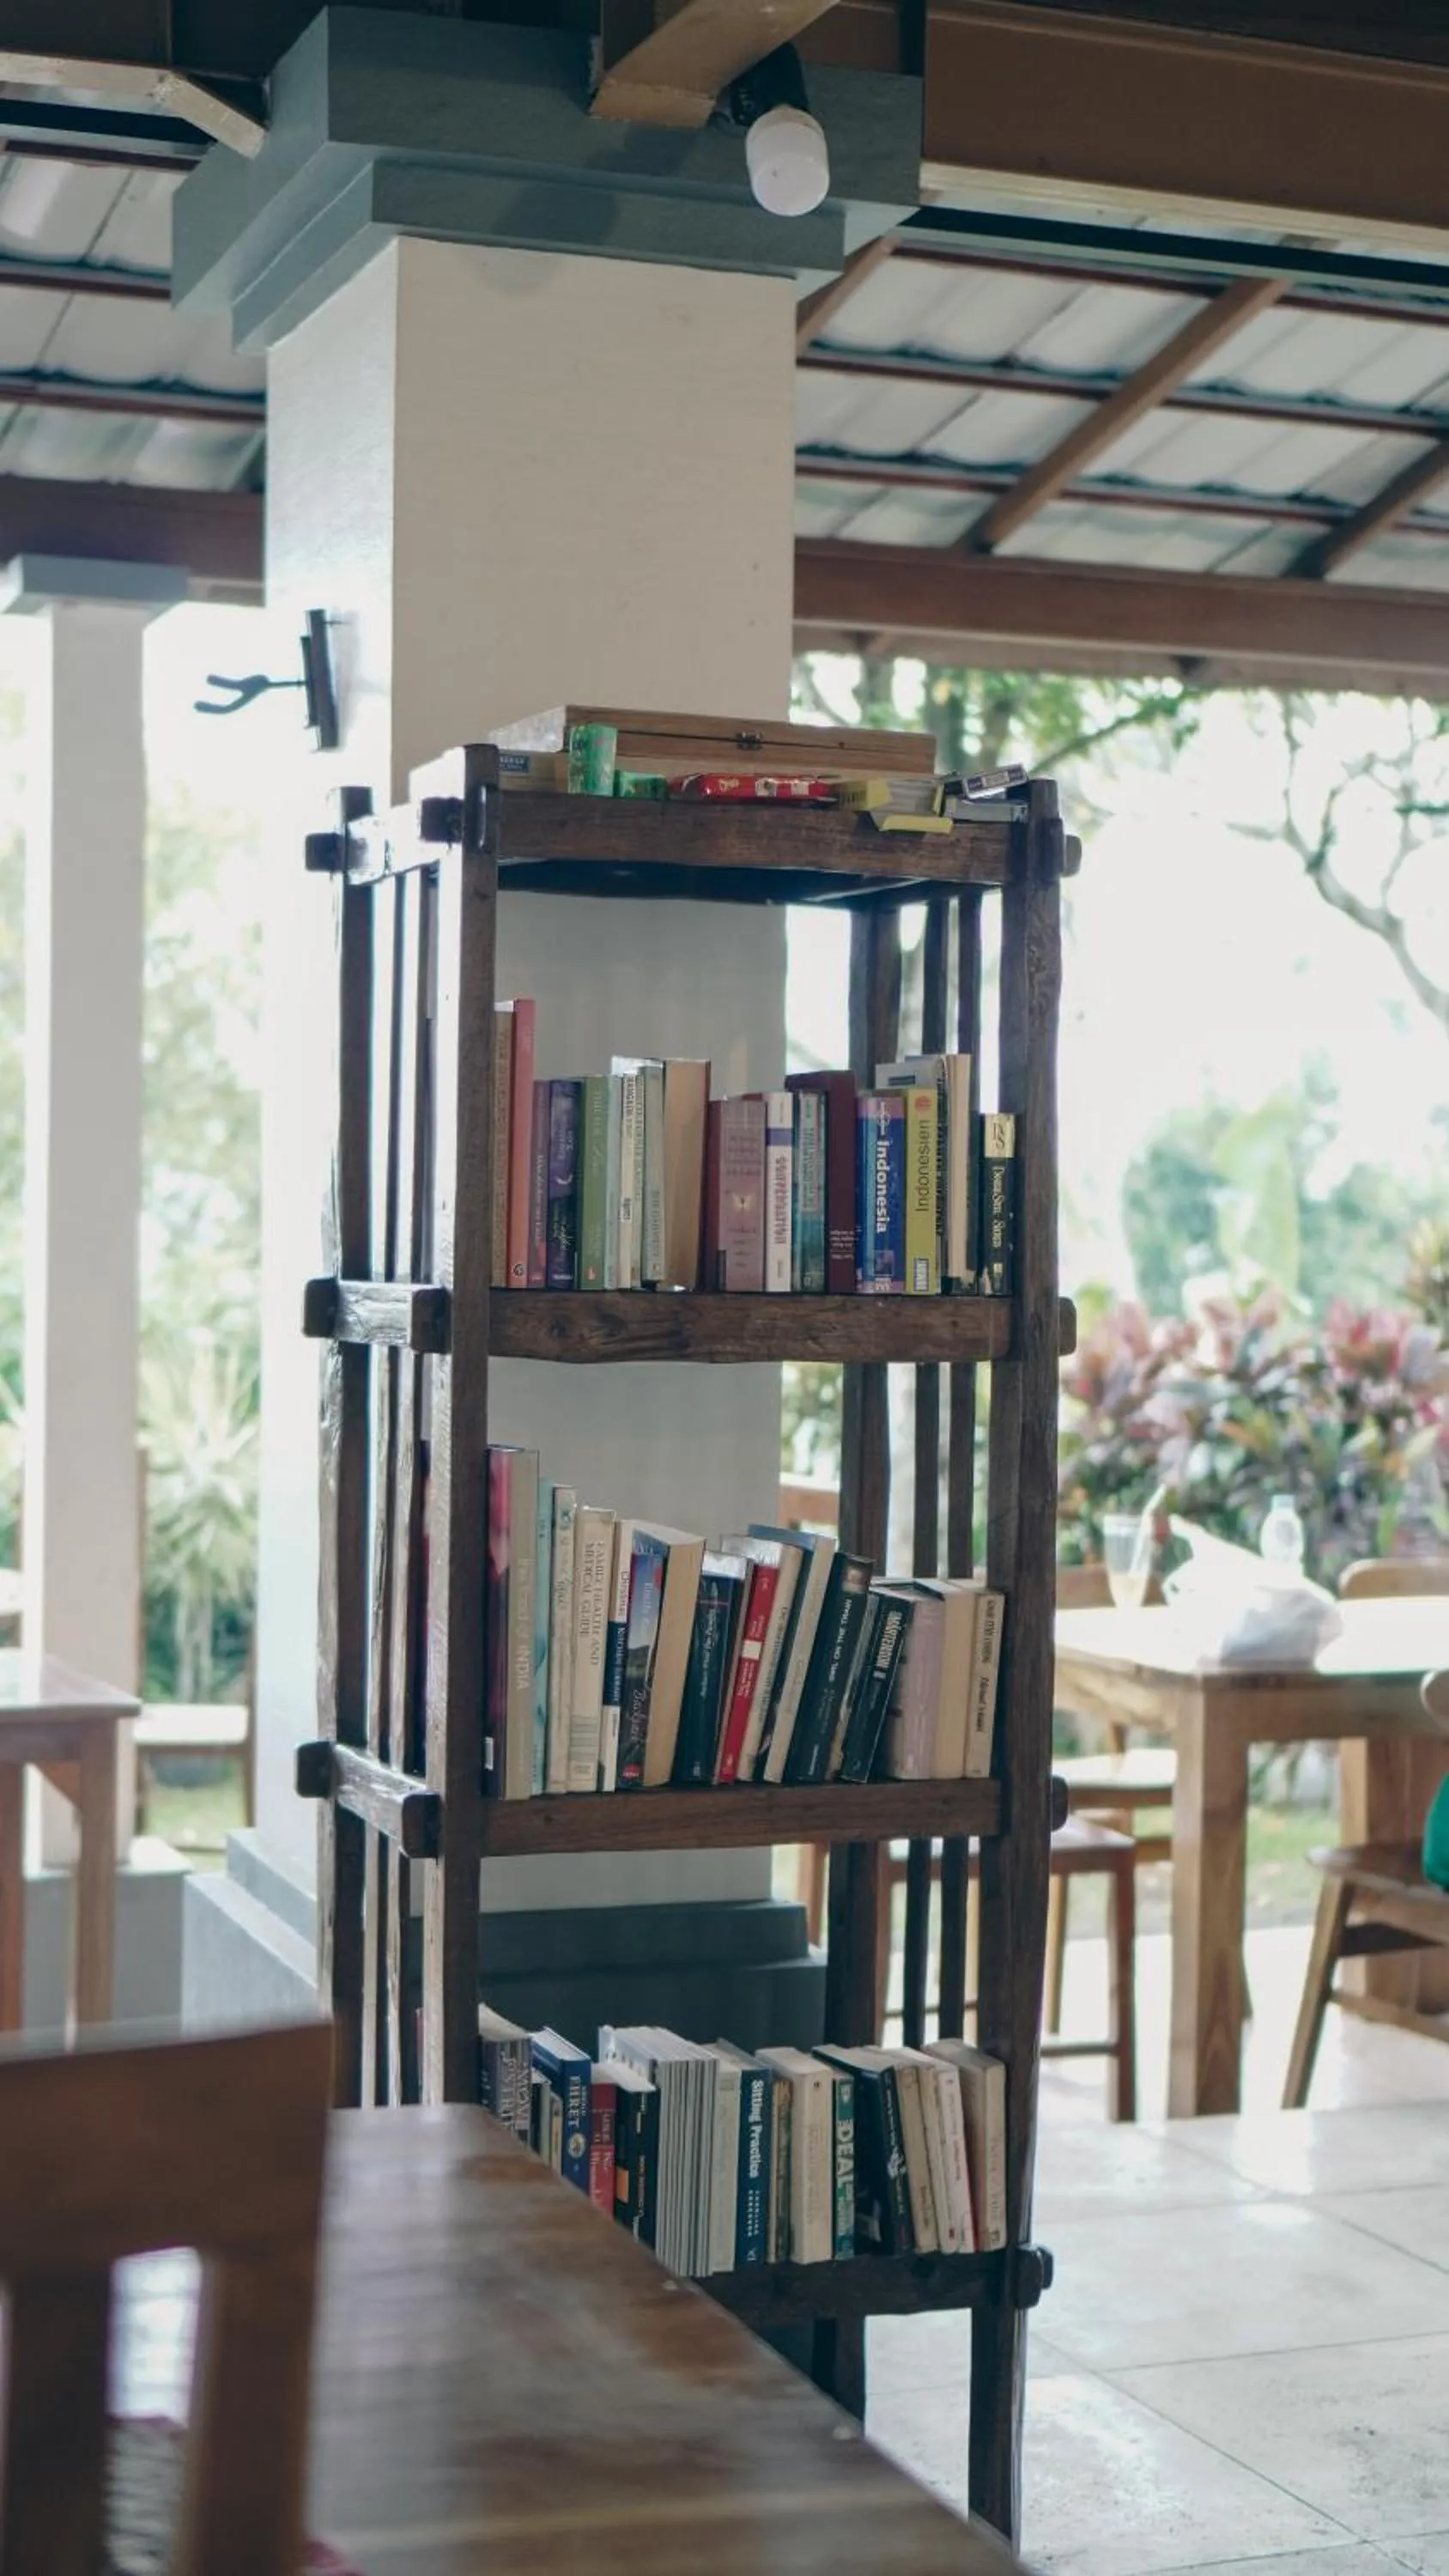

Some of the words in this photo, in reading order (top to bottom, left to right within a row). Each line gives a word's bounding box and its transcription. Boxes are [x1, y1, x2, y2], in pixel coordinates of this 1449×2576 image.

[876, 1139, 894, 1233] Indonesia
[915, 1119, 932, 1212] Indonesien
[582, 1543, 595, 1594] MEDICAL
[579, 1600, 591, 1637] GUIDE
[591, 1588, 604, 1634] HEALTH
[515, 1645, 531, 1692] INDIA
[590, 1637, 601, 1666] AND
[748, 2079, 765, 2123] Sitting
[749, 2125, 763, 2178] Practice
[836, 2126, 854, 2189] DEAL
